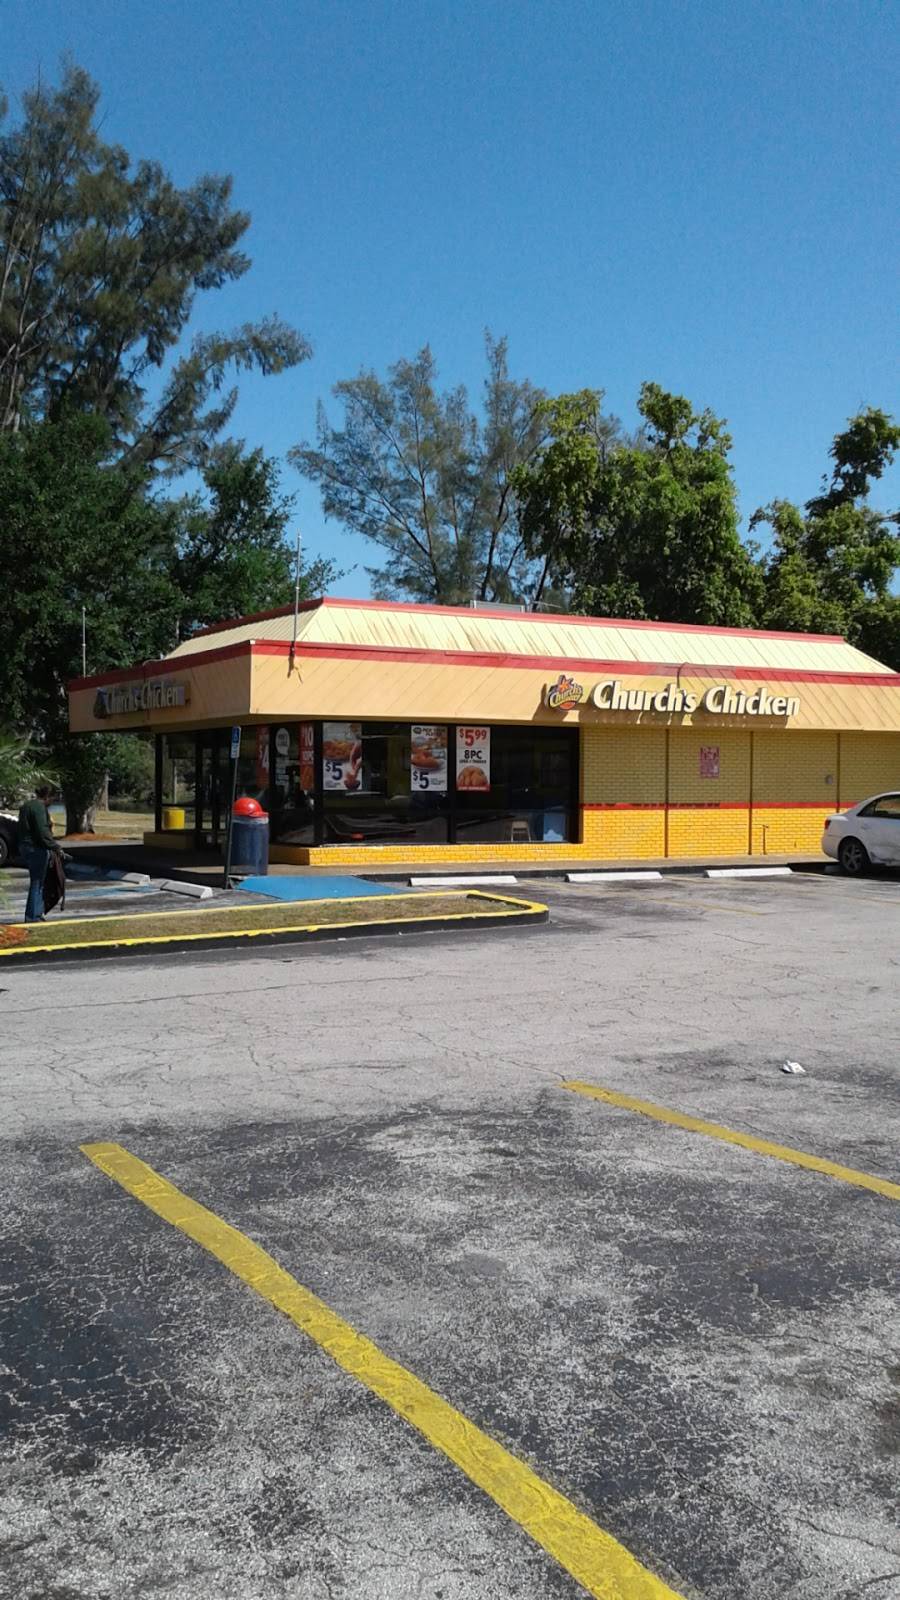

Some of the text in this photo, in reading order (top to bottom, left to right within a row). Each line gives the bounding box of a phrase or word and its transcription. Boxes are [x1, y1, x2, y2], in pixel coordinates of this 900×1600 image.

[141, 680, 178, 709] Chicken
[592, 680, 801, 716] Church's Chicken
[326, 760, 343, 780] $5
[412, 770, 429, 789] $5
